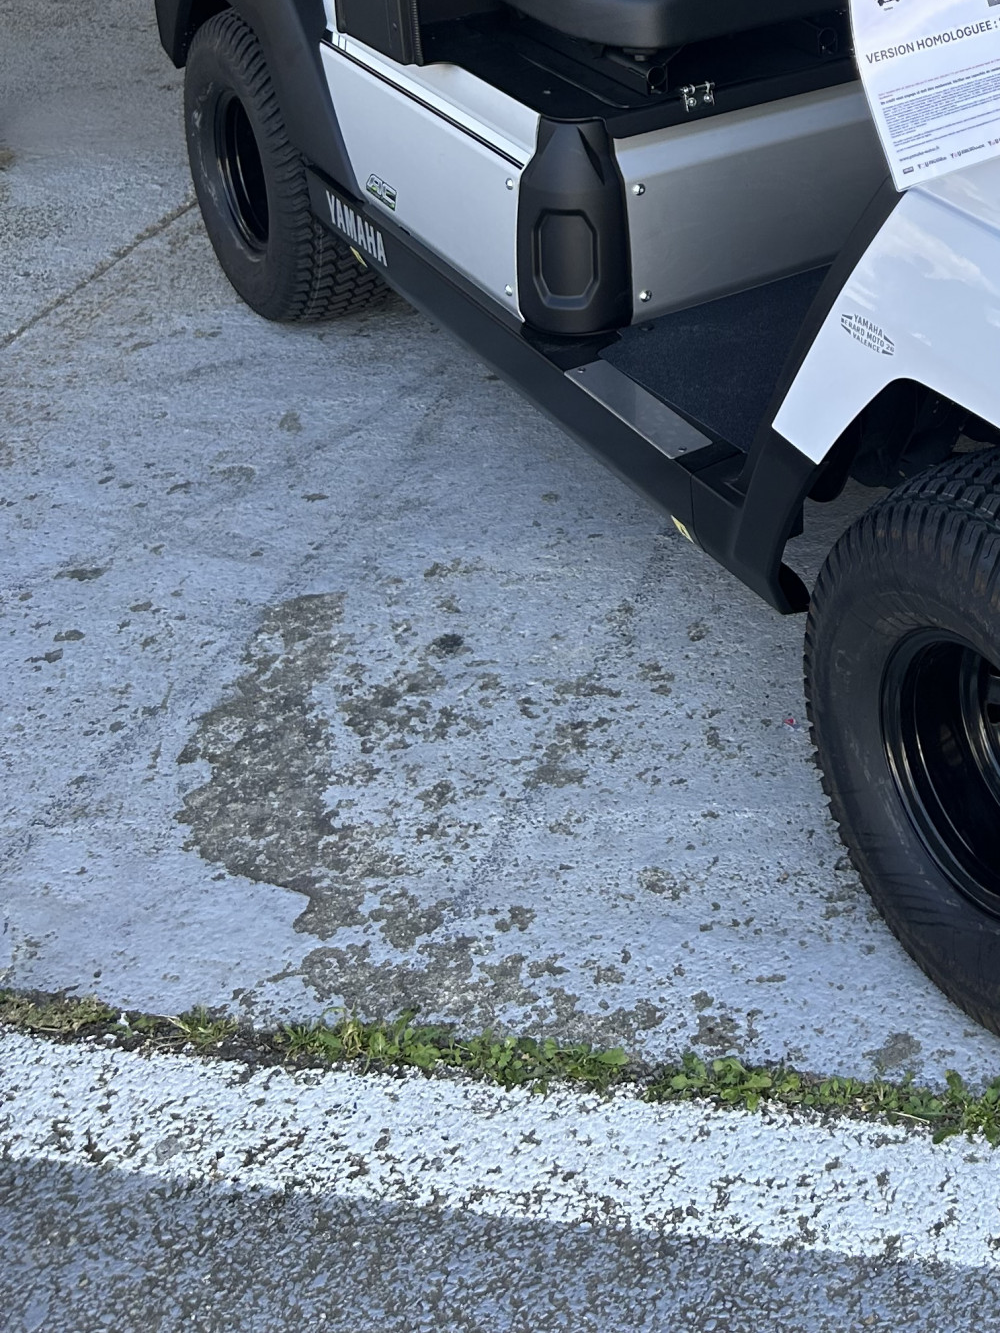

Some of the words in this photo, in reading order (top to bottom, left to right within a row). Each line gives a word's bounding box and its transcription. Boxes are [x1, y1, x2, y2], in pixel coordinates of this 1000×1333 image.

[866, 42, 914, 64] VERSION
[917, 19, 993, 50] HOMOLOGUEE
[326, 189, 388, 267] YAMAHA
[854, 313, 883, 338] YAMAHA
[853, 332, 880, 353] VALENCE
[866, 331, 885, 348] MOTO
